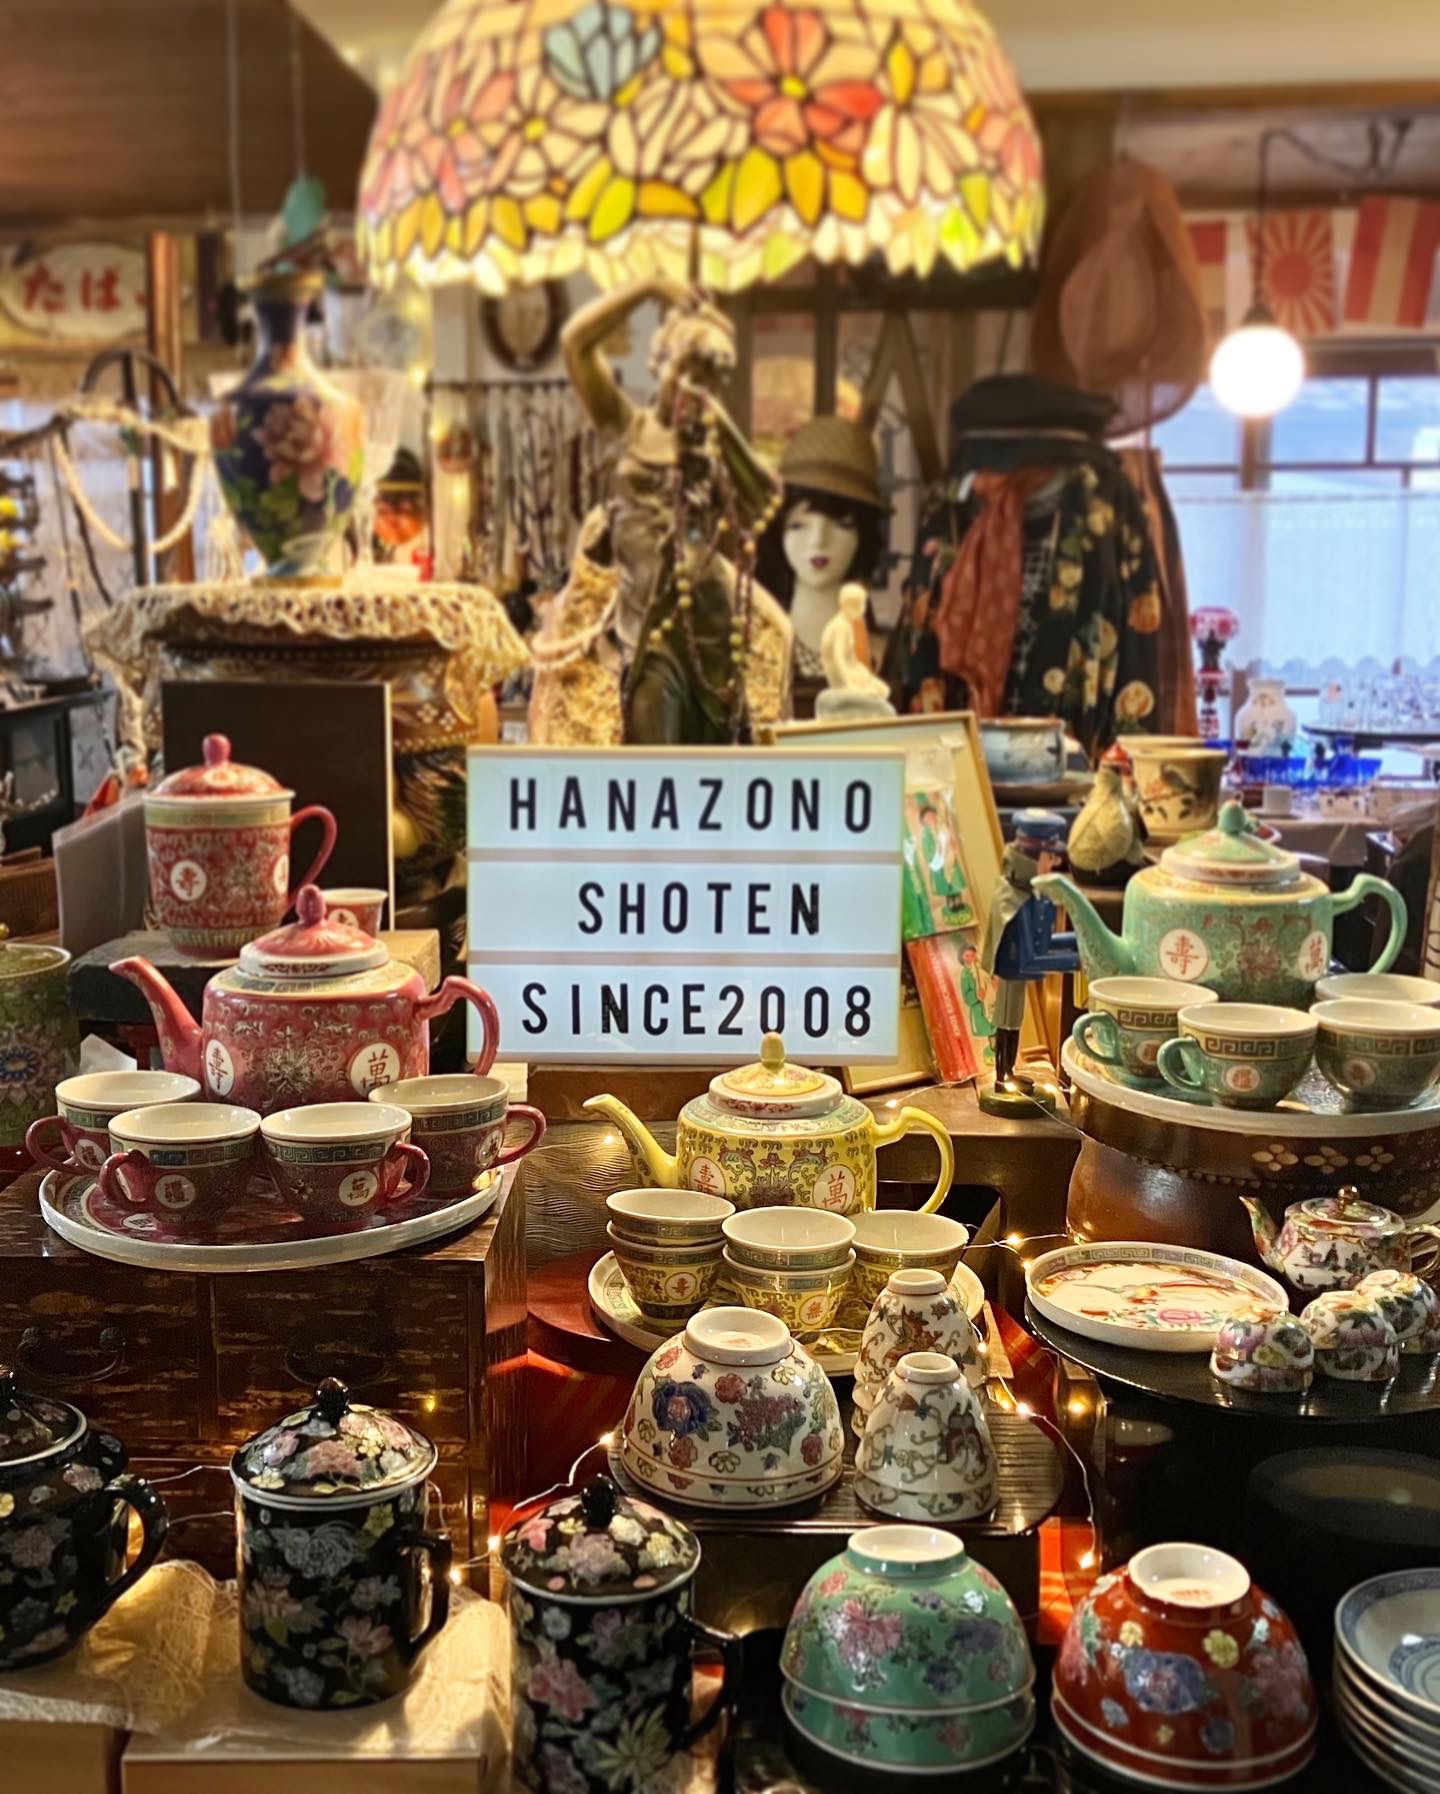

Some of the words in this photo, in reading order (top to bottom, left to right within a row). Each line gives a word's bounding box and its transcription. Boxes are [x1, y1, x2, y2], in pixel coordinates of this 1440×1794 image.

[510, 776, 872, 833] HANAZONO
[577, 881, 820, 935] SHOTEN
[361, 1048, 391, 1088] 萬
[823, 1171, 848, 1209] 萬
